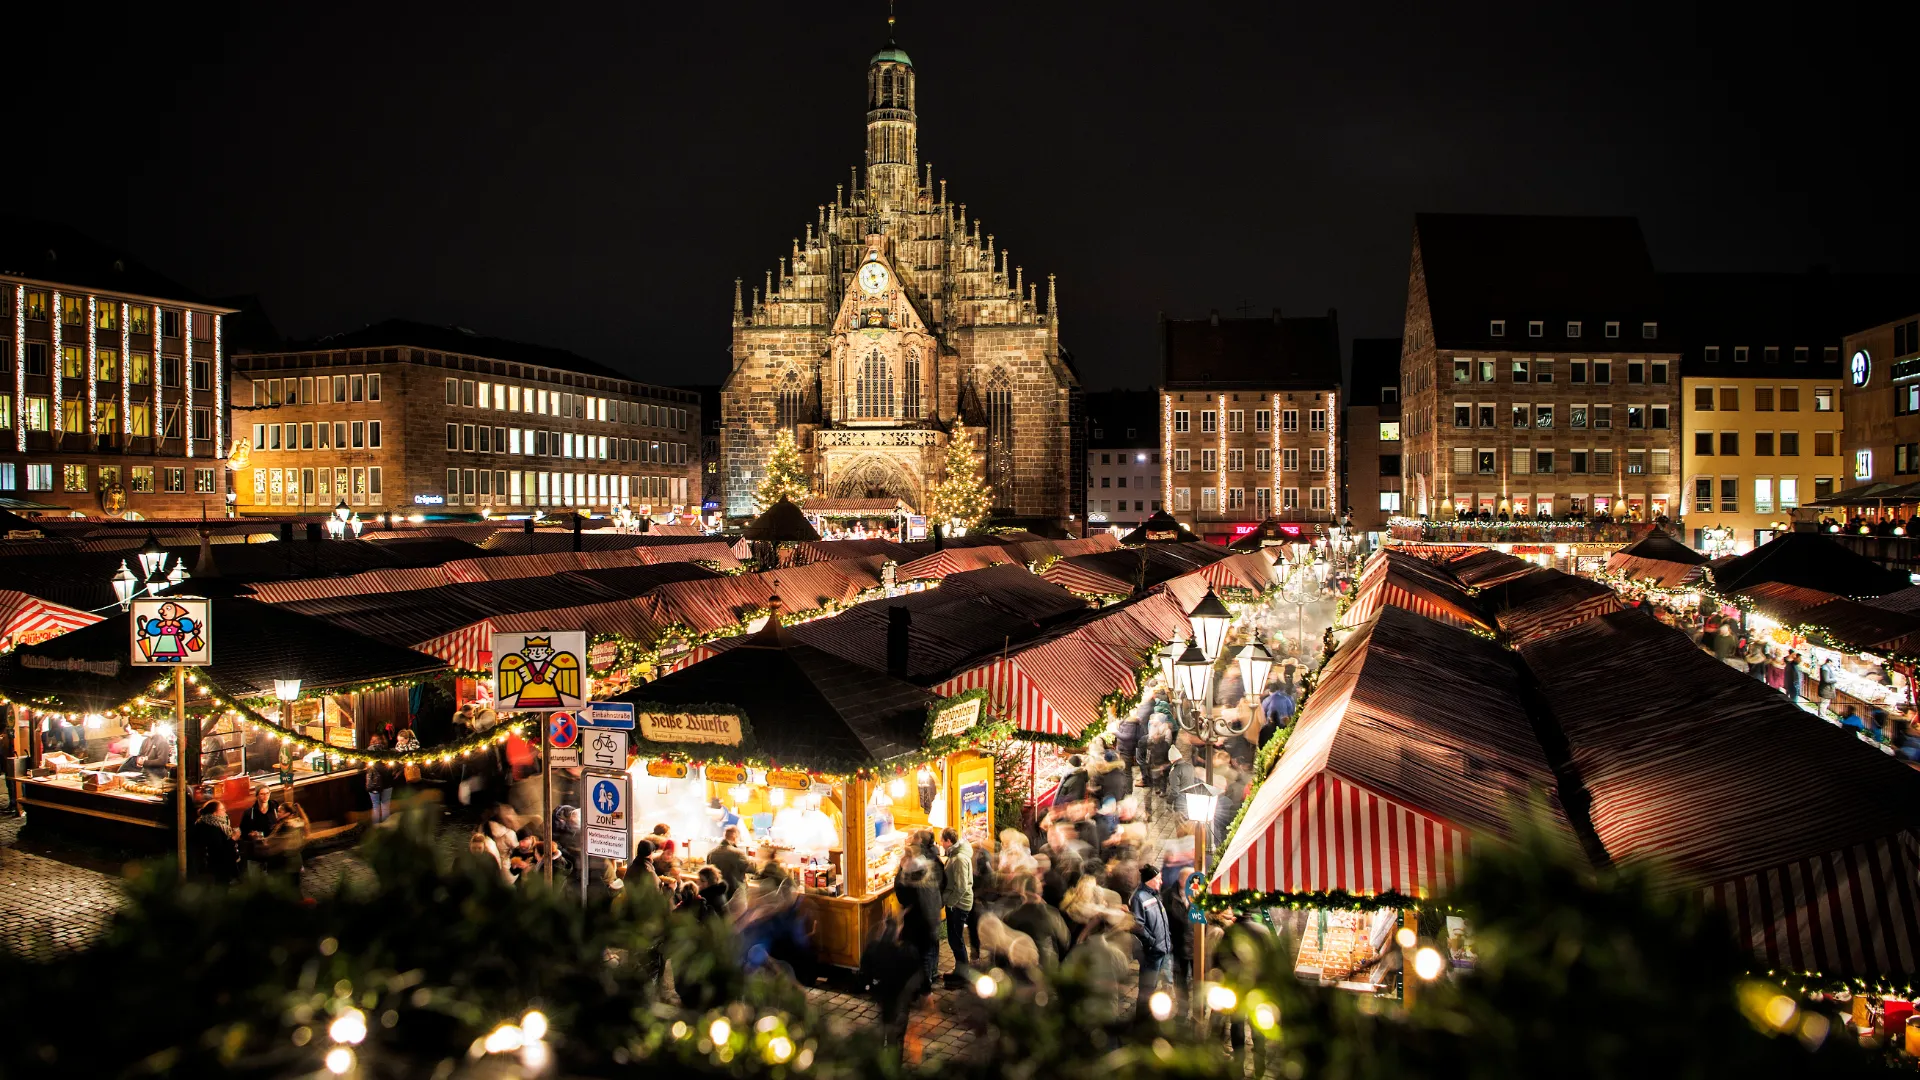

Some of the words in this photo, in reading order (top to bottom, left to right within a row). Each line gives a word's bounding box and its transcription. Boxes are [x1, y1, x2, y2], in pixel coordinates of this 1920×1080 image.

[592, 711, 631, 720] Einbahnstraße
[596, 815, 617, 826] ZONE
[1191, 912, 1202, 920] WC
